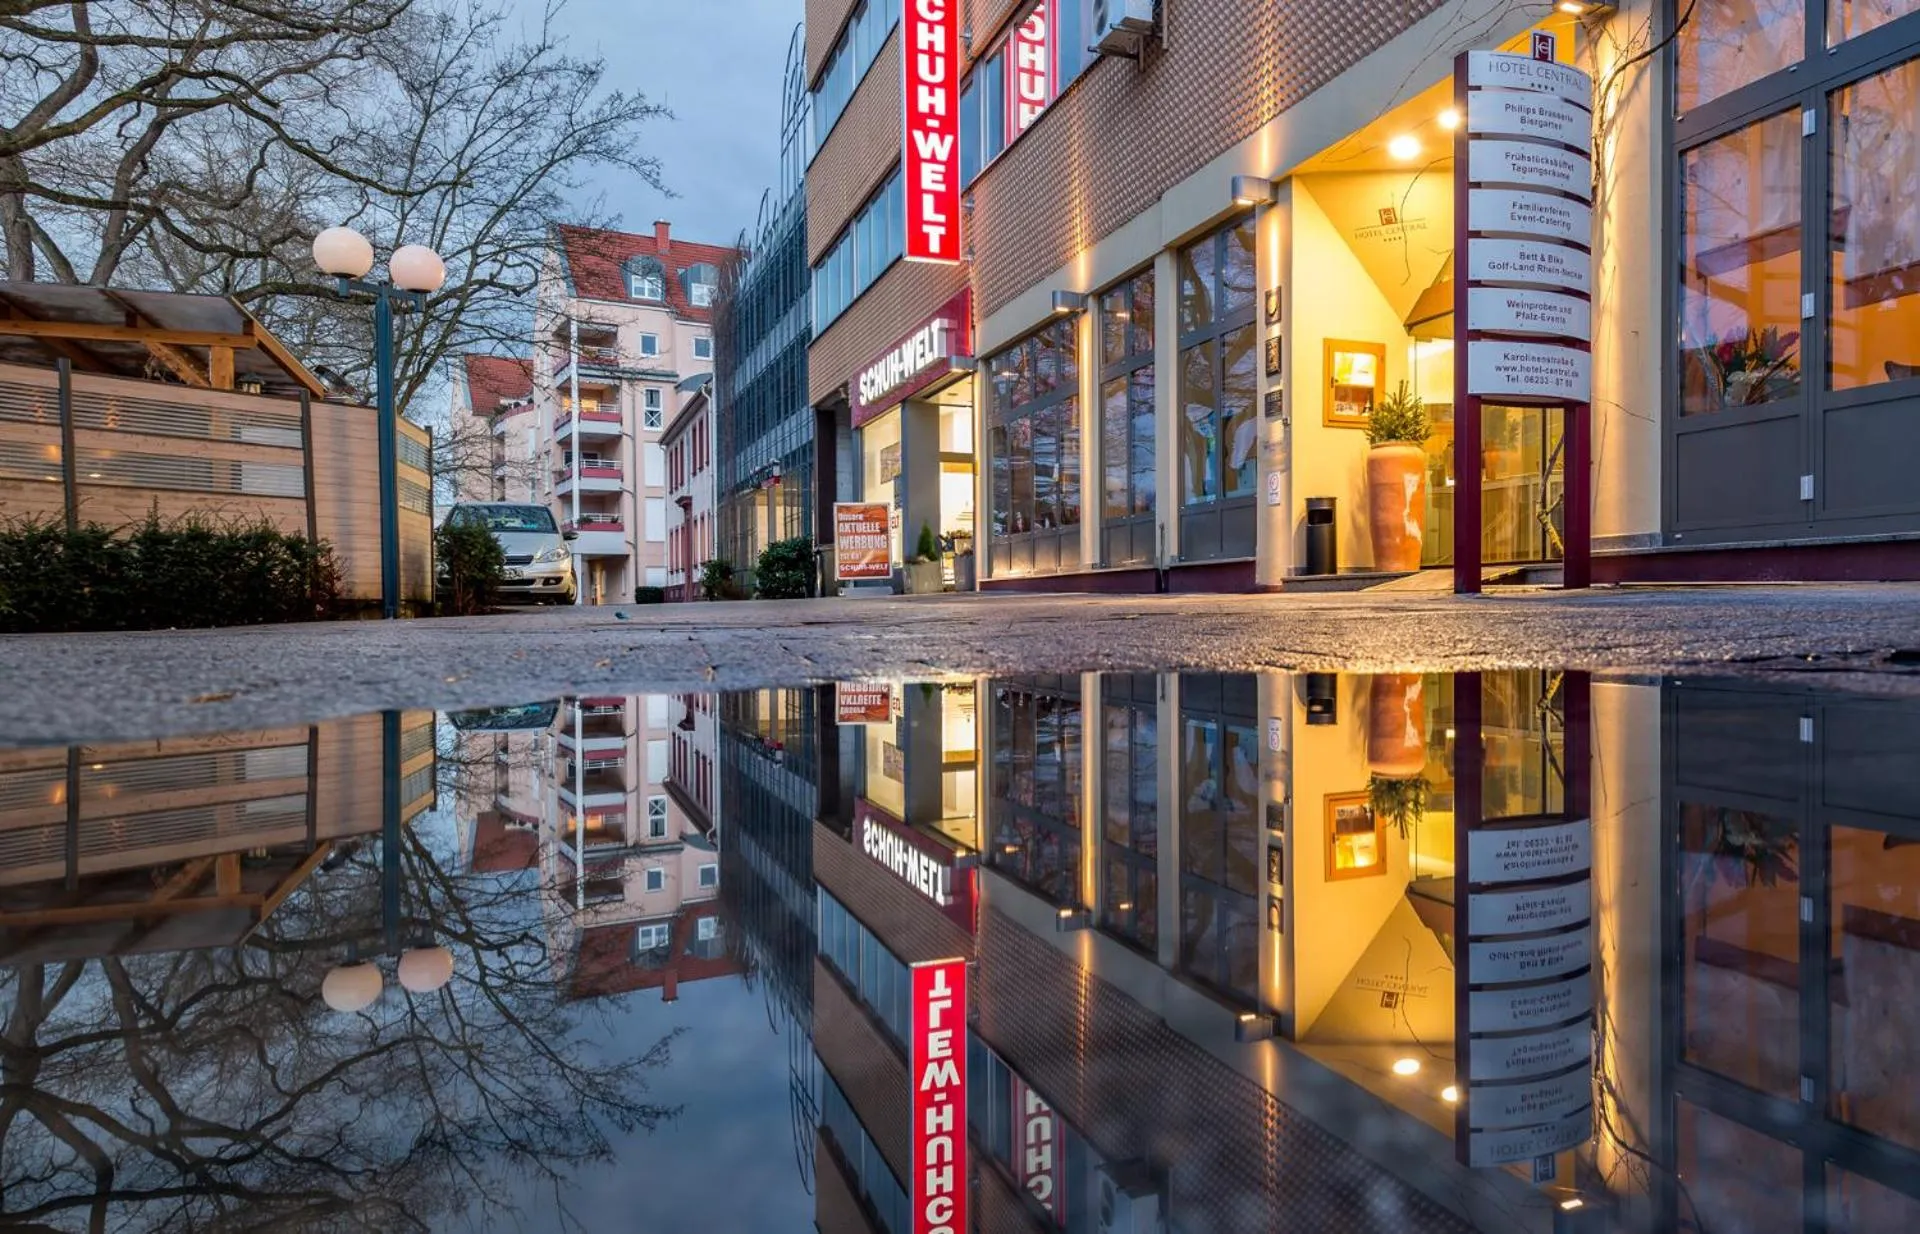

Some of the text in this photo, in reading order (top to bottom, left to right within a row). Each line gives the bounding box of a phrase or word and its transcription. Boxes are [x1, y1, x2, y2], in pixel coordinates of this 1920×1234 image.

[1489, 60, 1584, 91] HOTEL CENTRAL
[1504, 103, 1537, 116] Philips
[1510, 212, 1572, 232] Event-Catering
[1519, 252, 1538, 261] Bett
[1540, 254, 1546, 262] &
[1488, 261, 1535, 272] Golf-Land
[1506, 300, 1558, 313] Weinproben
[858, 317, 949, 407] SCHUH-WELT
[838, 521, 881, 533] AKTUELLE
[839, 534, 887, 550] WERBUNG
